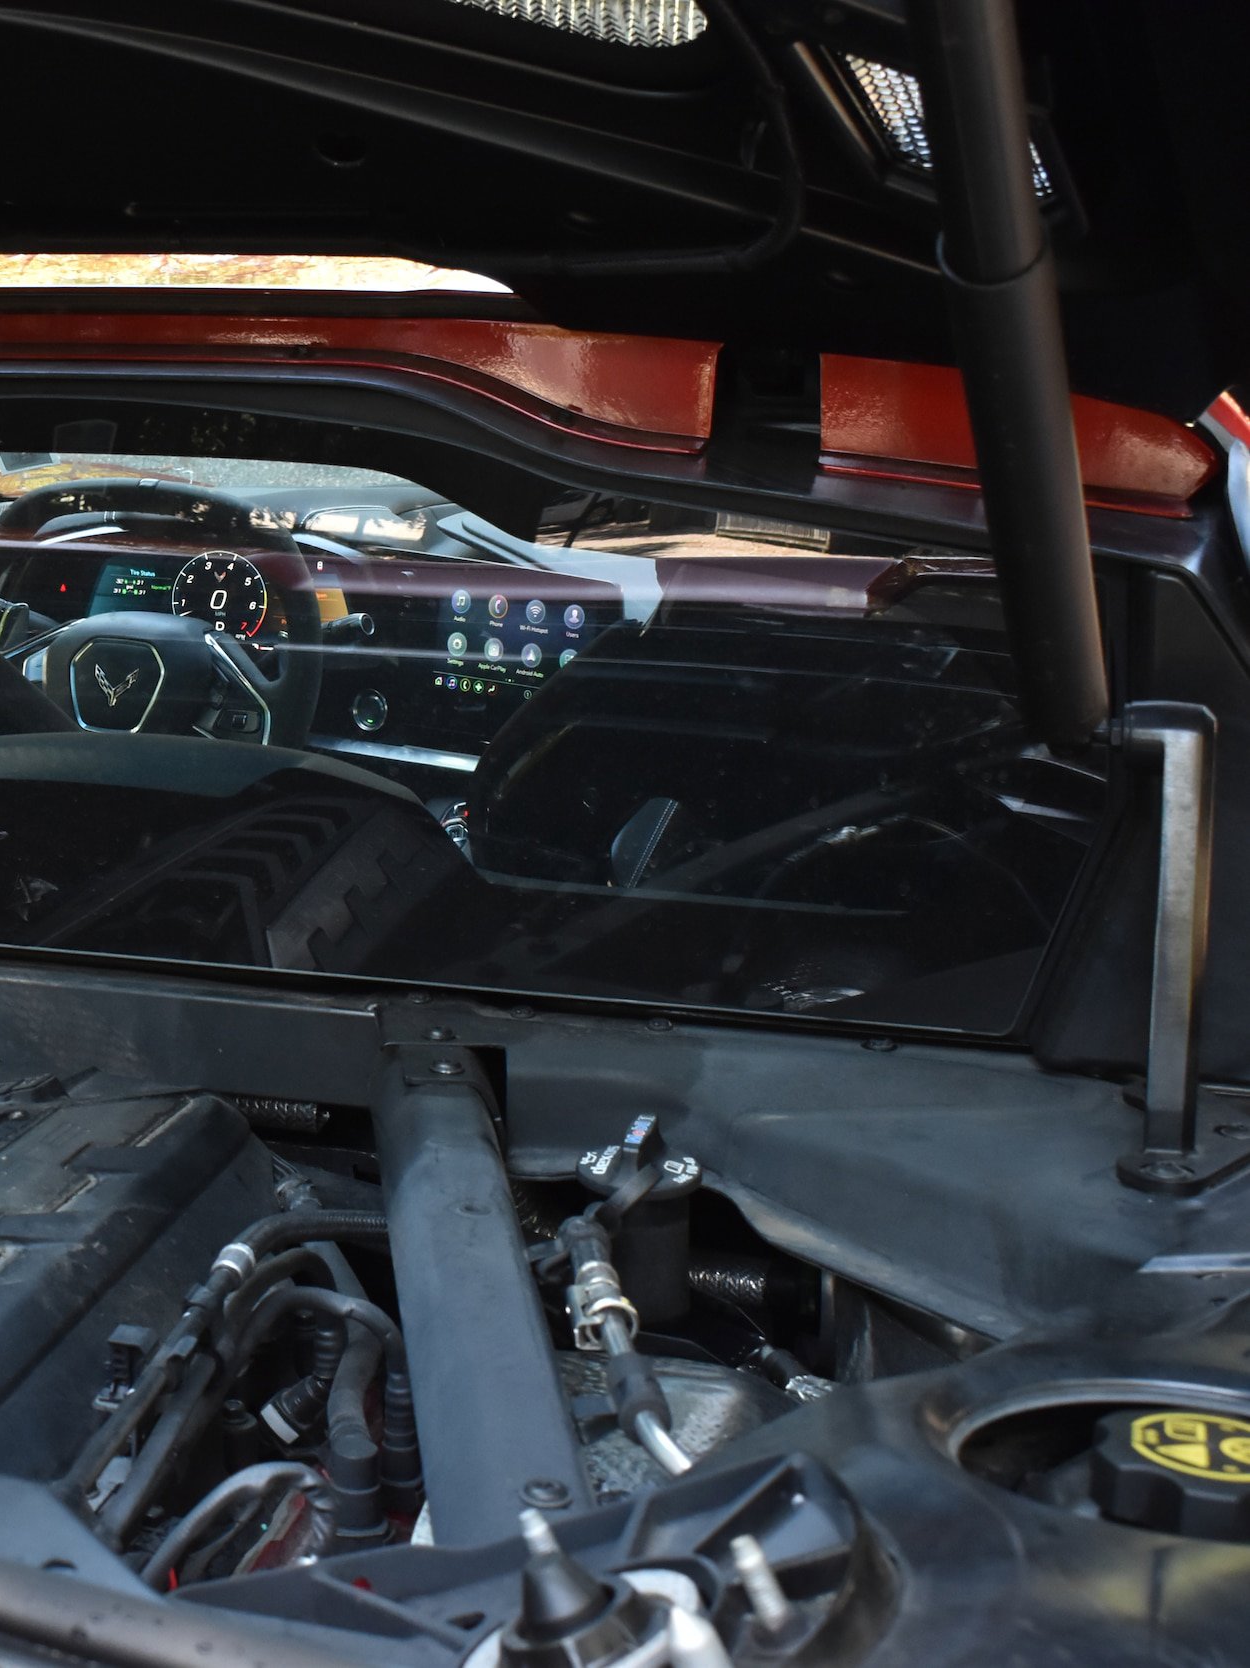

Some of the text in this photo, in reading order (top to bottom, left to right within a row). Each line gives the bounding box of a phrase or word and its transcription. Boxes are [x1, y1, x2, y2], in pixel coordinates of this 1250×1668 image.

[205, 562, 212, 570] 3
[186, 575, 194, 583] 2
[244, 577, 252, 586] 5
[181, 599, 186, 607] 1
[210, 590, 227, 610] 0
[249, 601, 256, 610] 6
[215, 621, 225, 631] D
[240, 622, 248, 630] 7
[565, 631, 579, 639] Users
